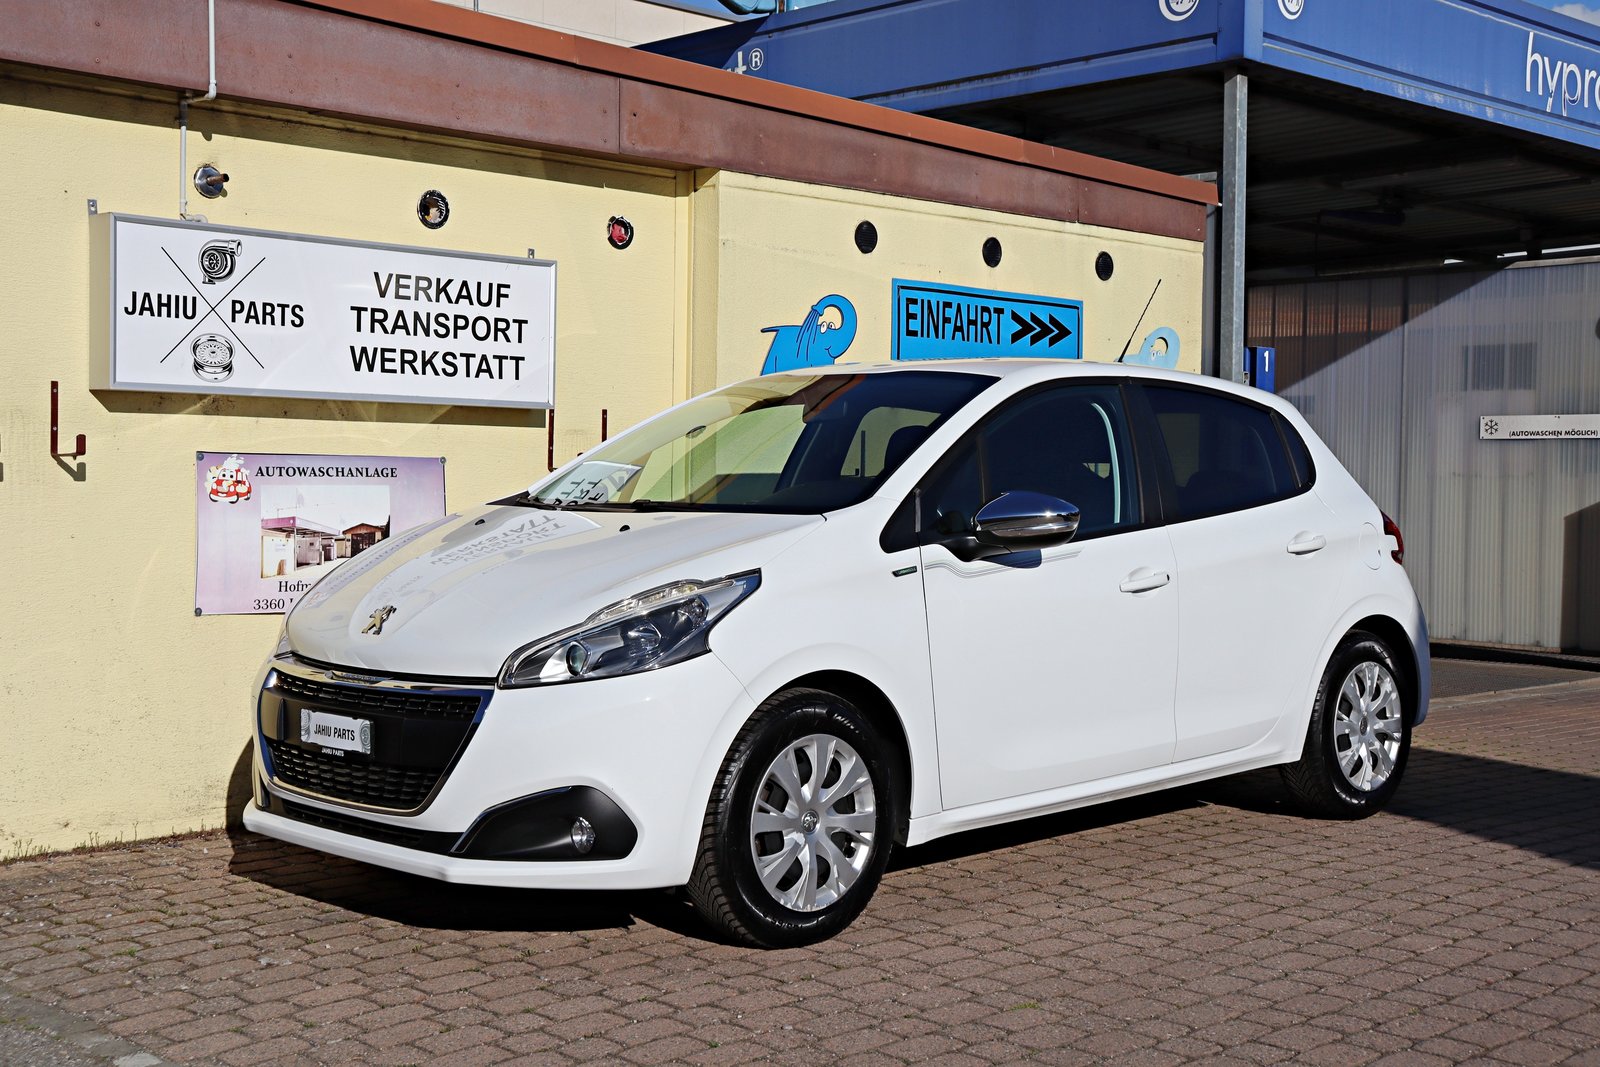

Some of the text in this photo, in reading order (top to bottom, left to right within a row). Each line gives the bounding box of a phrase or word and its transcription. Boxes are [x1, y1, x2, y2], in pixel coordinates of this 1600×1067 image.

[1526, 31, 1600, 116] hypr
[373, 271, 511, 308] VERKAUF
[124, 291, 305, 328] JAHIU PARTS
[350, 306, 528, 344] TRANSPORT
[905, 297, 1004, 345] EINFAHRT
[350, 345, 526, 380] WERKSTATT
[1263, 350, 1269, 372] 1
[1509, 428, 1598, 438] (AUTOWASCHEN MÖGLICH)
[255, 465, 398, 478] AUTOWASCHANLAGE
[253, 598, 285, 610] 3360
[314, 724, 355, 741] JAHIU PARTS
